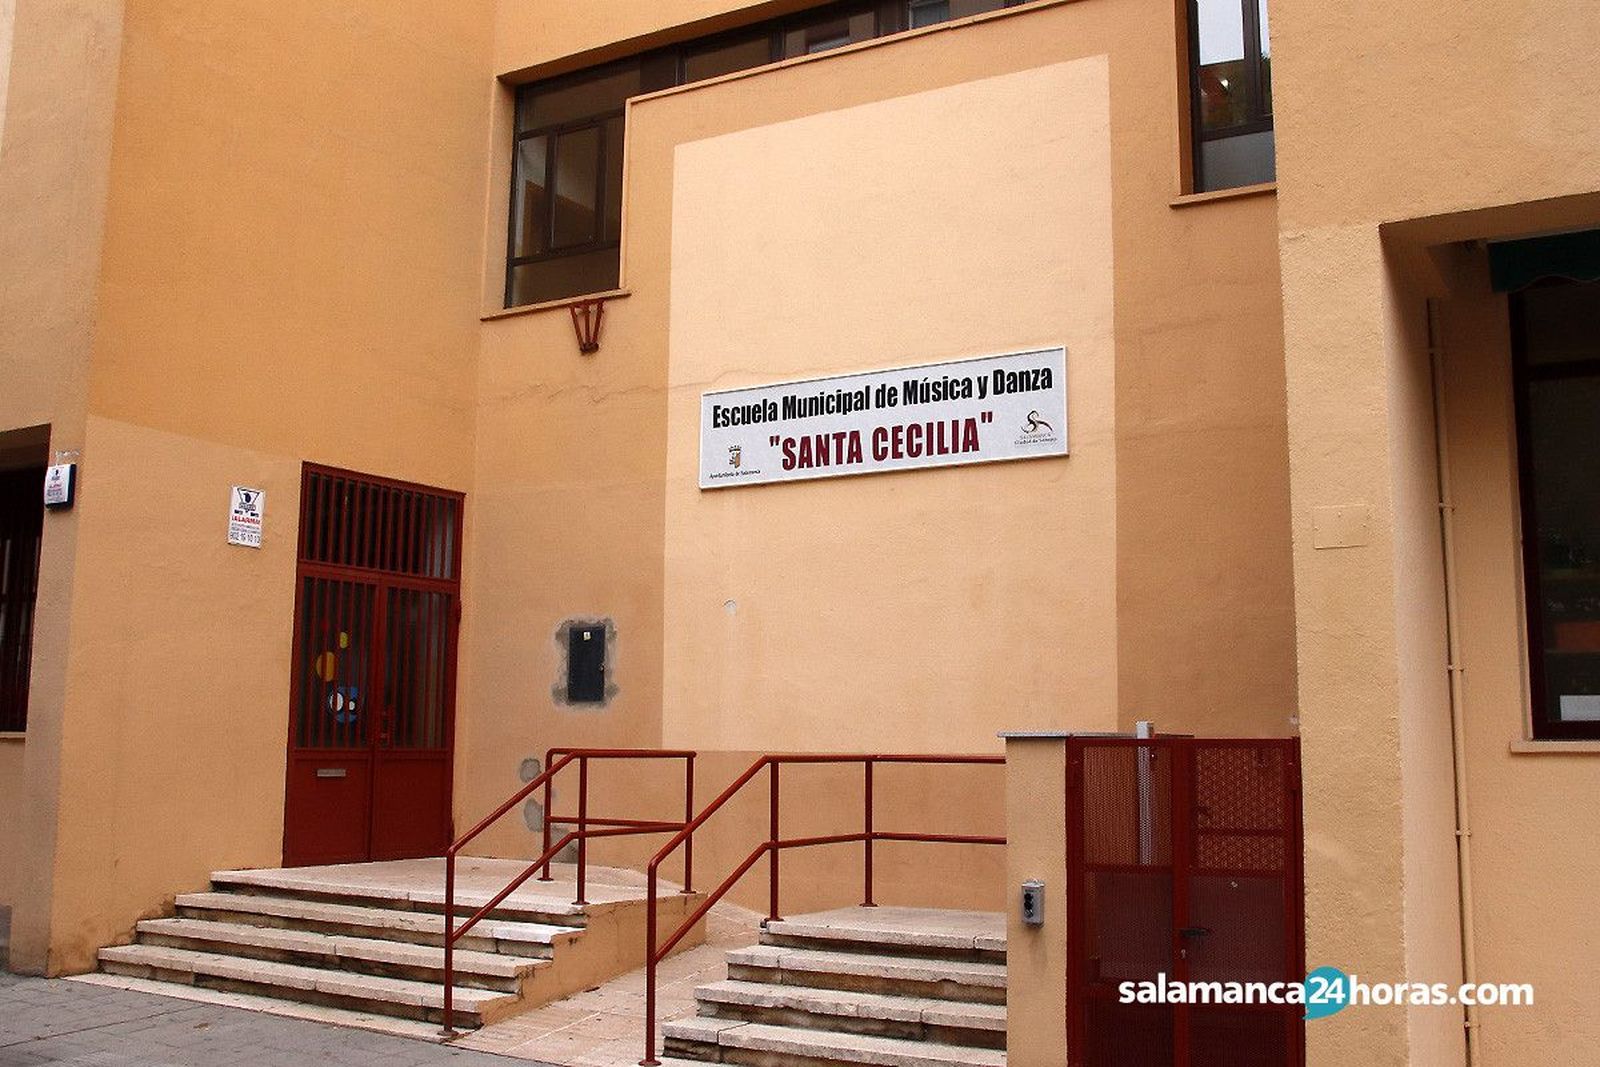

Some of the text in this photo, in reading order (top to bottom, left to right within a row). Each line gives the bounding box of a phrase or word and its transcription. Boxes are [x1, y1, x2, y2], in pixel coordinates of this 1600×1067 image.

[713, 368, 1053, 429] Escuela Municipal de Música y Danza
[769, 411, 993, 471] "SANTA CECILIA"
